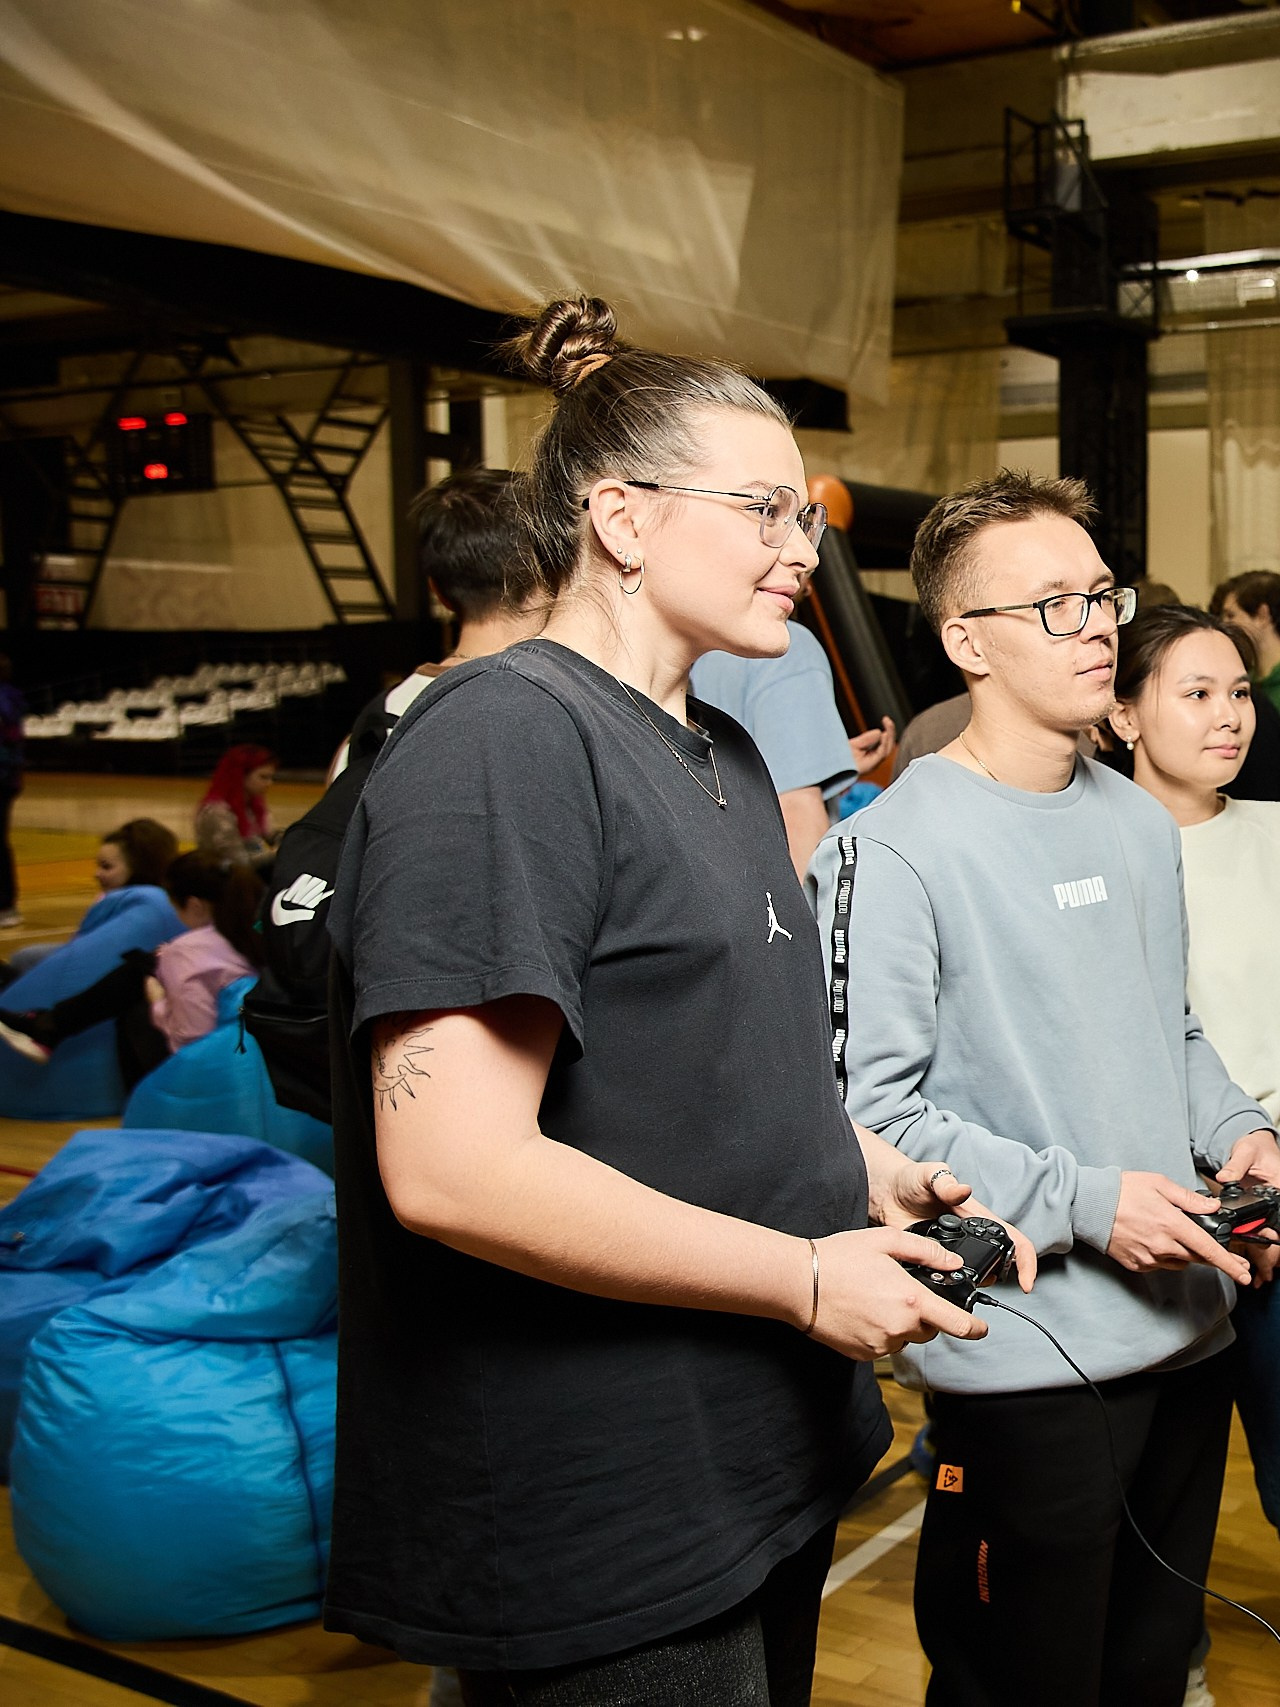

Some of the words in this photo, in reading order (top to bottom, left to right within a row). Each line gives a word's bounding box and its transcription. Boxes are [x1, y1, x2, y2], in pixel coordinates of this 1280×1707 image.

[1053, 875, 1108, 910] PUMA
[834, 929, 846, 964] PUMA
[832, 1028, 846, 1062] PUMA
